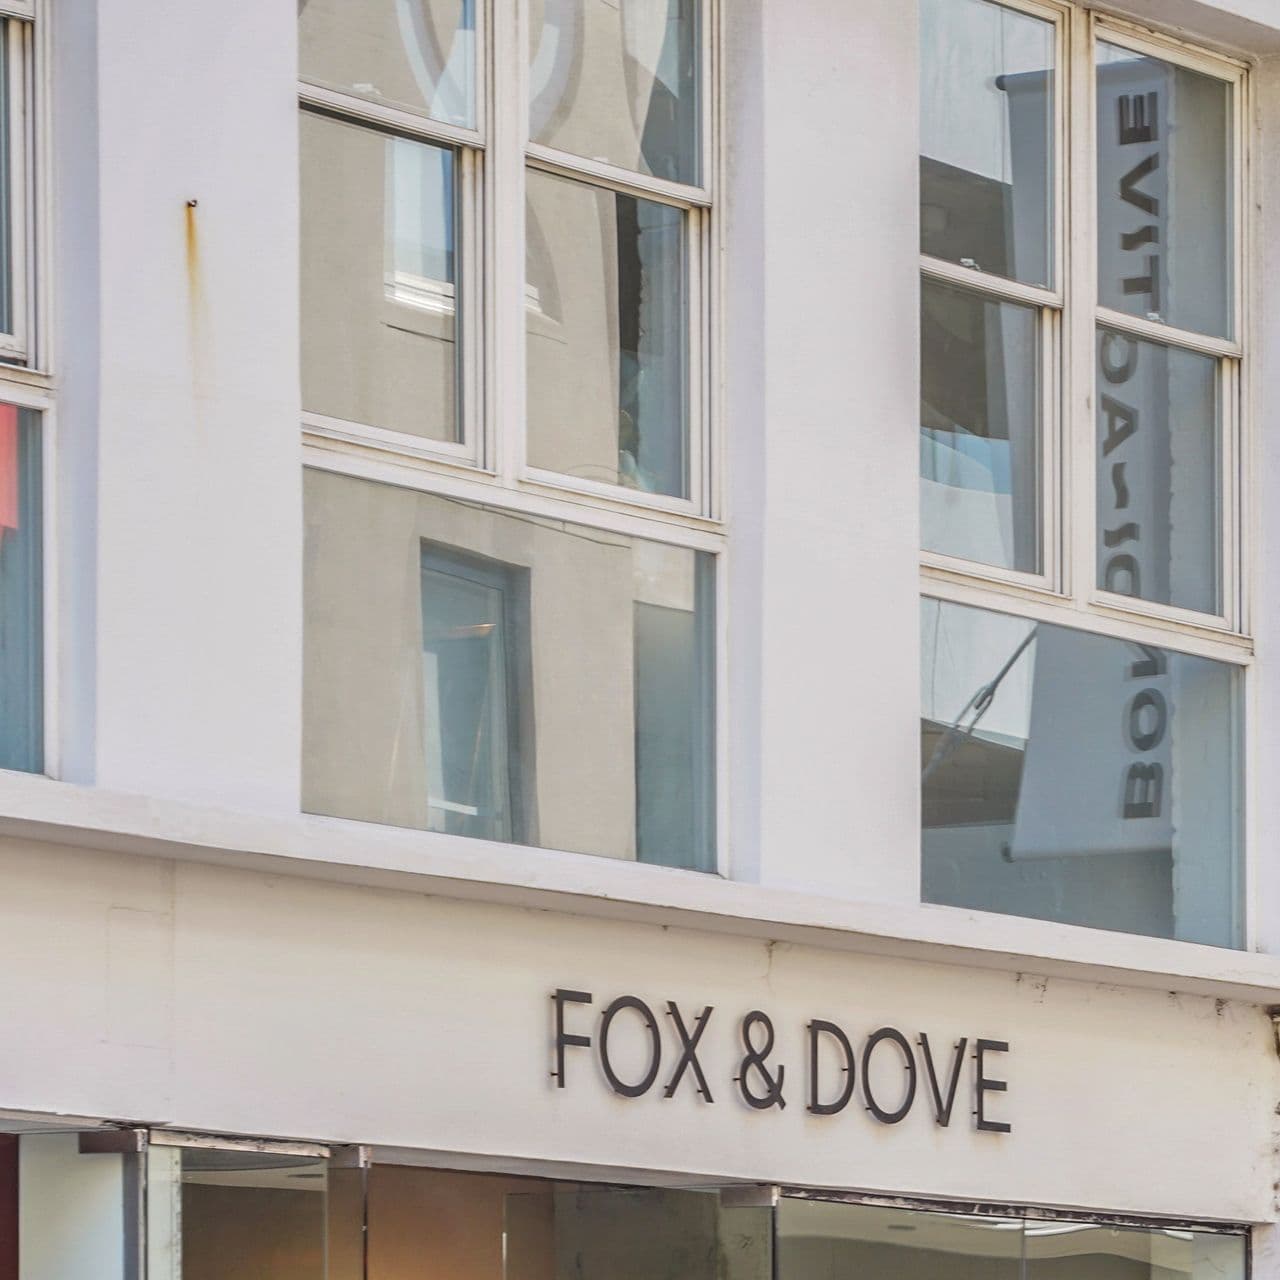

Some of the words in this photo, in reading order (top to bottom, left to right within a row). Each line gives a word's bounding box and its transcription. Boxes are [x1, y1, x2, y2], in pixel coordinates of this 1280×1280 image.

[553, 988, 714, 1104] FOX
[738, 1009, 786, 1111] &
[808, 1018, 1011, 1133] DOVE
